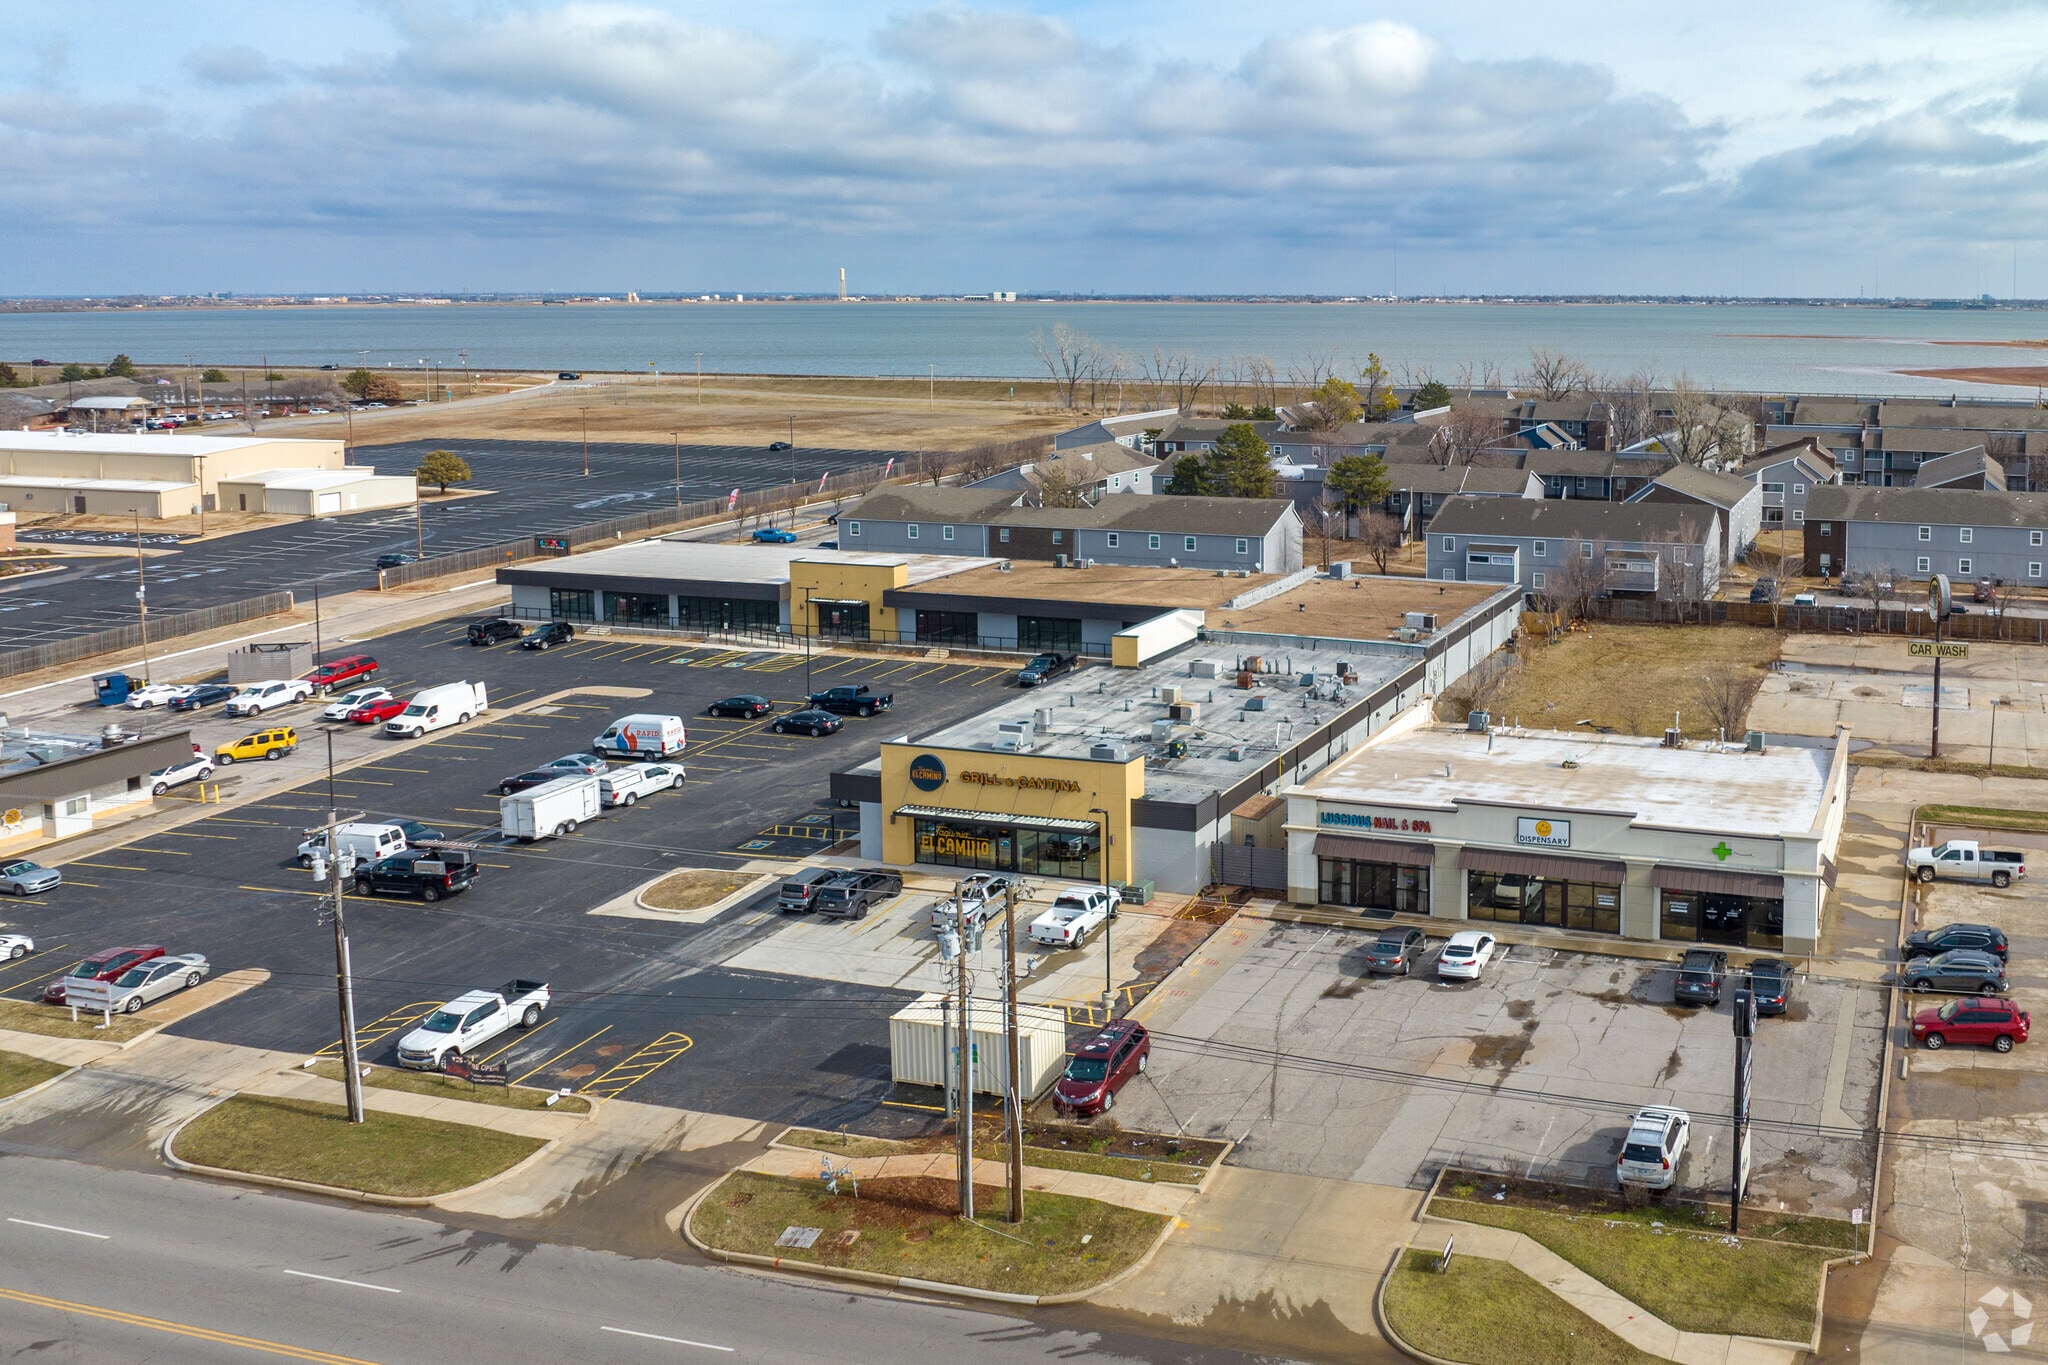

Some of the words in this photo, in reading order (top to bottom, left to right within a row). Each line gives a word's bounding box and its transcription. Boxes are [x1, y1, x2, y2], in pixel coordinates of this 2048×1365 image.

[1911, 644, 1931, 655] CAR
[1936, 645, 1966, 657] WASH
[636, 729, 660, 737] RAPID
[960, 771, 1001, 786] GRILL
[1005, 778, 1013, 787] &
[1017, 776, 1081, 792] CANTINA
[1320, 812, 1371, 828] LUSCIOUS
[1374, 817, 1398, 830] NAIL
[1401, 819, 1409, 831] &
[1412, 820, 1431, 833] SPA
[921, 836, 934, 849] EL
[937, 837, 989, 857] CAMINO
[1520, 835, 1568, 845] DISPENSARY
